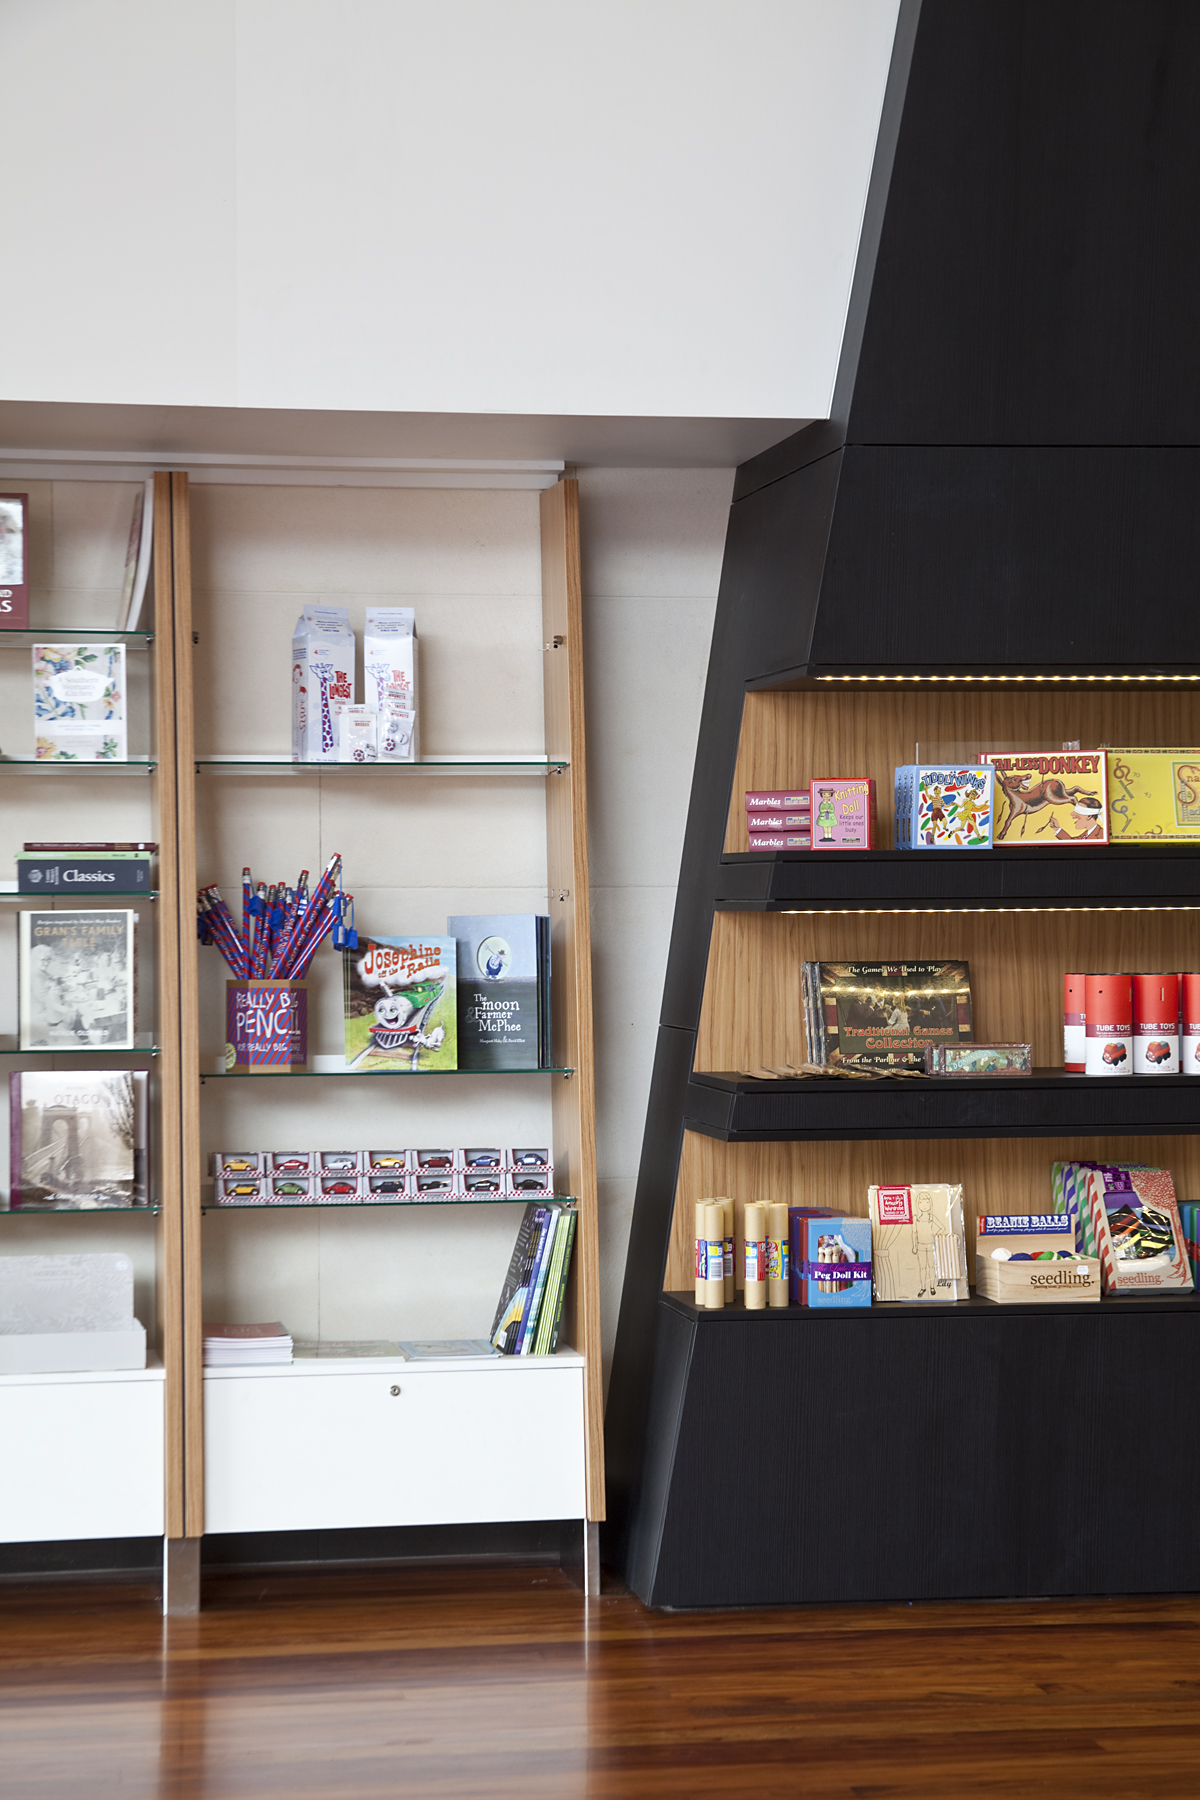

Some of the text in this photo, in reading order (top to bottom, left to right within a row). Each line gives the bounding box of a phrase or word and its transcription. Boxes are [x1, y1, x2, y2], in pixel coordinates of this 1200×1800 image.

[991, 756, 1100, 775] TAIL-LESS DONKEY
[921, 771, 987, 790] TIDDLYWINKS
[834, 783, 869, 802] Knitting
[749, 797, 781, 806] Marbles
[842, 799, 859, 815] Doll
[751, 818, 782, 826] Marbles
[752, 838, 784, 847] Marbles
[62, 869, 116, 882] Classics
[34, 925, 125, 937] GRAN'S FAMILY
[62, 937, 97, 947] TABLE
[364, 943, 442, 975] Josephine
[406, 959, 441, 979] Rails
[862, 965, 884, 974] Games
[886, 965, 898, 973] We
[926, 965, 942, 974] Play
[236, 991, 275, 1010] REALLY
[473, 993, 487, 1002] The
[481, 1000, 520, 1011] moon
[475, 1007, 513, 1019] Farmer
[478, 1018, 521, 1032] McPhee
[843, 1025, 954, 1037] Traditional Games
[1096, 1024, 1115, 1032] TUBE
[1160, 1022, 1175, 1030] TOYS
[247, 1042, 272, 1052] REALLY
[865, 1036, 934, 1049] Collection
[840, 1056, 860, 1064] From
[901, 1055, 909, 1063] &
[54, 1093, 101, 1105] OTAGO
[986, 1216, 1029, 1228] BEANIE
[1030, 1215, 1069, 1227] BALLS
[814, 1270, 868, 1280] Peg Doll Kit
[1030, 1270, 1095, 1288] seedling.
[1117, 1272, 1165, 1286] seedling.
[936, 1280, 952, 1288] Lily
